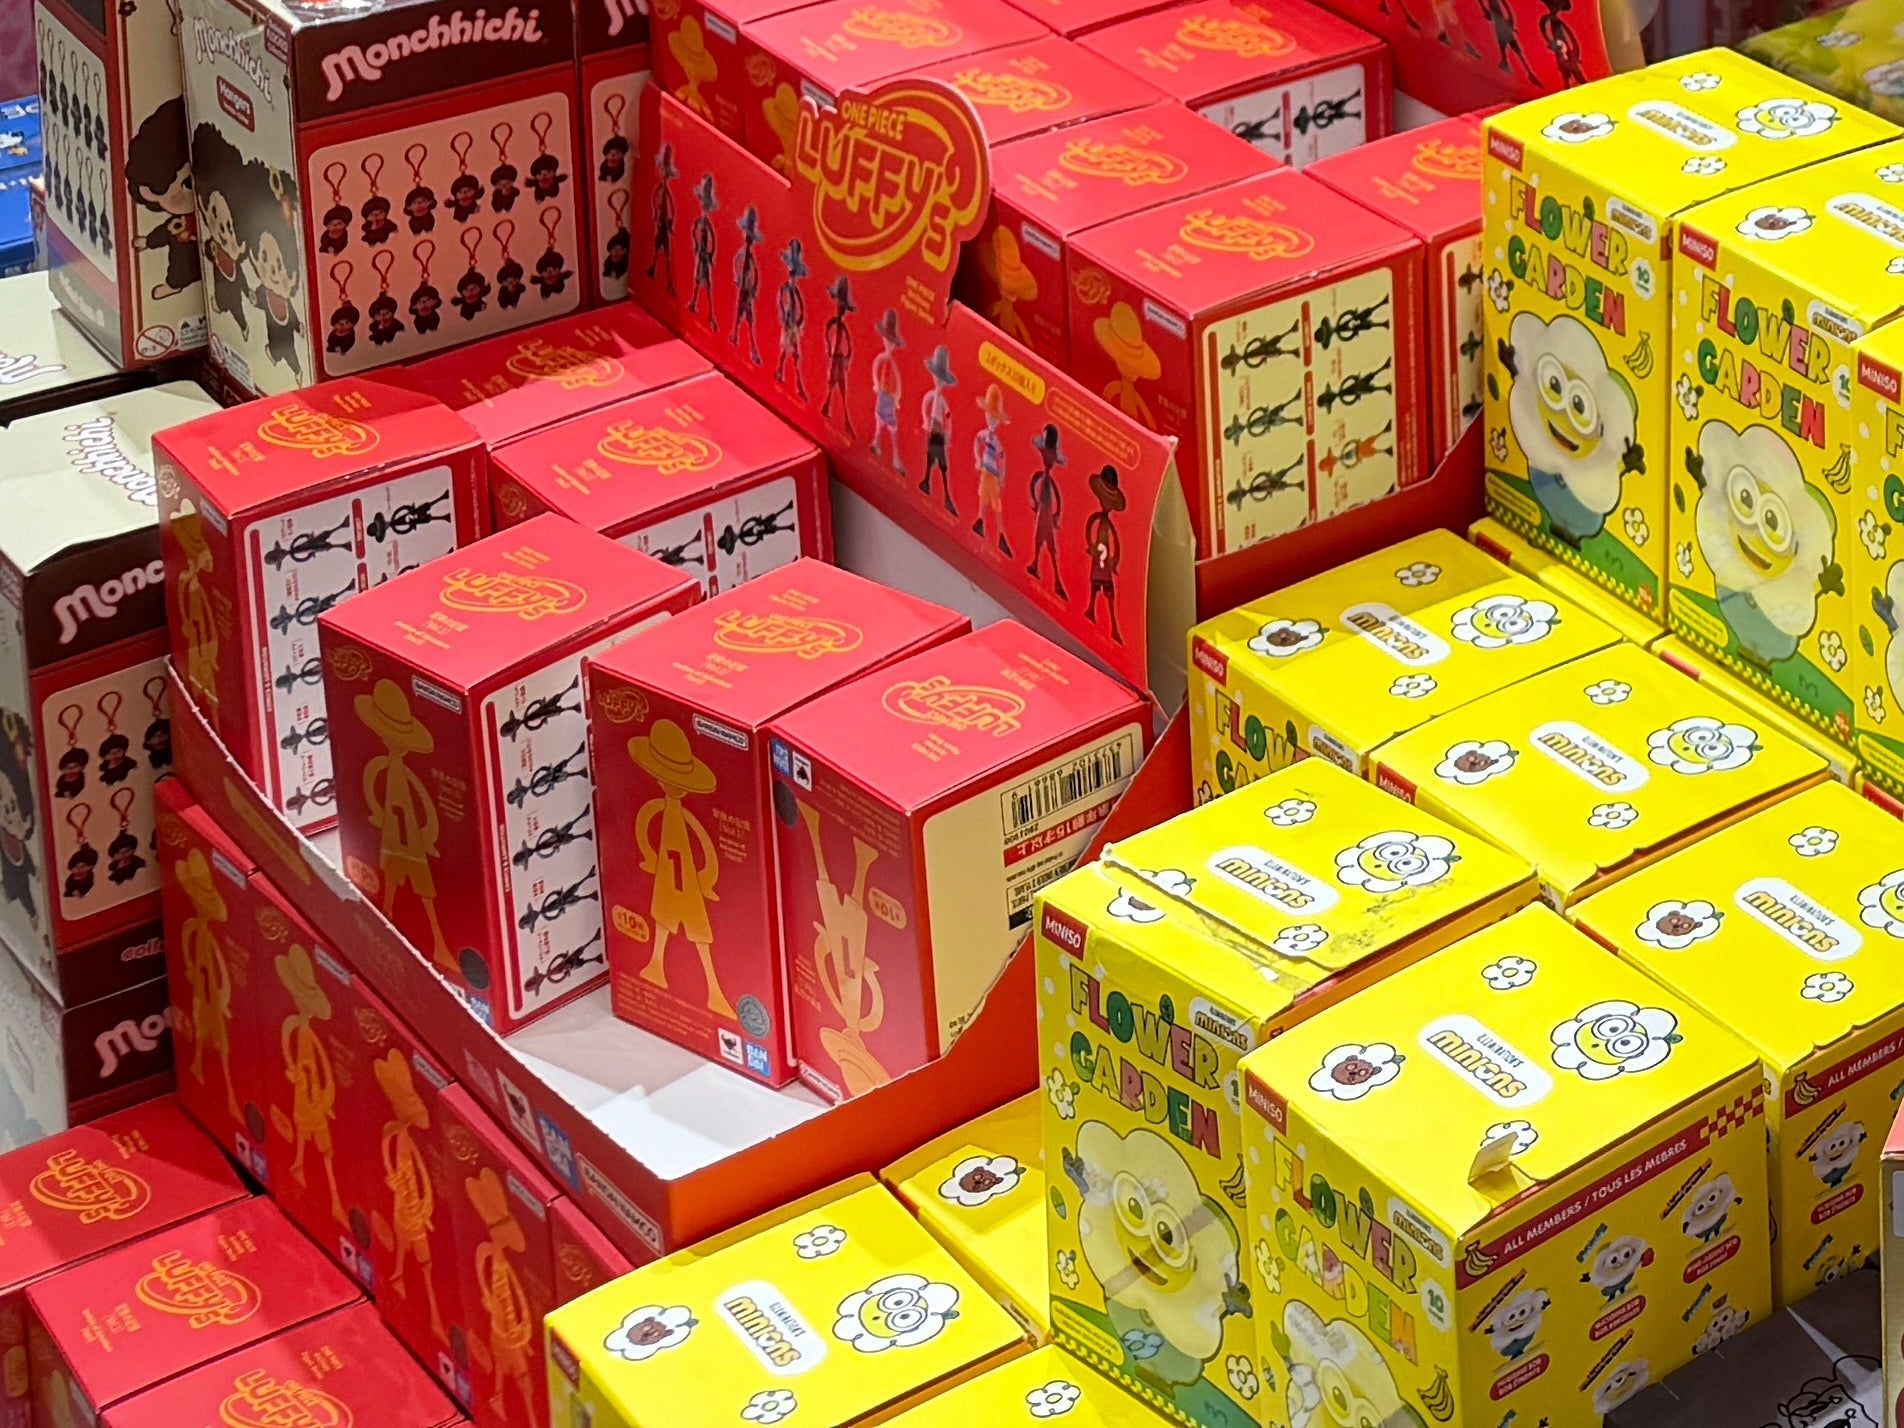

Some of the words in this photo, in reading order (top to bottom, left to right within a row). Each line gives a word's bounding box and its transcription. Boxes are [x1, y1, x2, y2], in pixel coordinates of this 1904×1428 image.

[193, 17, 272, 103] Monchhichi
[321, 6, 542, 101] Monchhichi
[842, 100, 868, 126] ONE
[868, 105, 906, 139] PIECE
[1860, 364, 1897, 393] MINISO
[1217, 857, 1314, 911] minions
[1046, 908, 1083, 949] MINISO
[1070, 966, 1221, 1091] FLOWER
[1428, 1028, 1526, 1100] minions
[1071, 1031, 1221, 1156] GARDEN
[1504, 1239, 1521, 1254] ALL
[1524, 1200, 1579, 1244] MEMBERS
[1583, 1194, 1590, 1209] /
[1592, 1180, 1623, 1206] TOUS
[1625, 1166, 1645, 1188] LES
